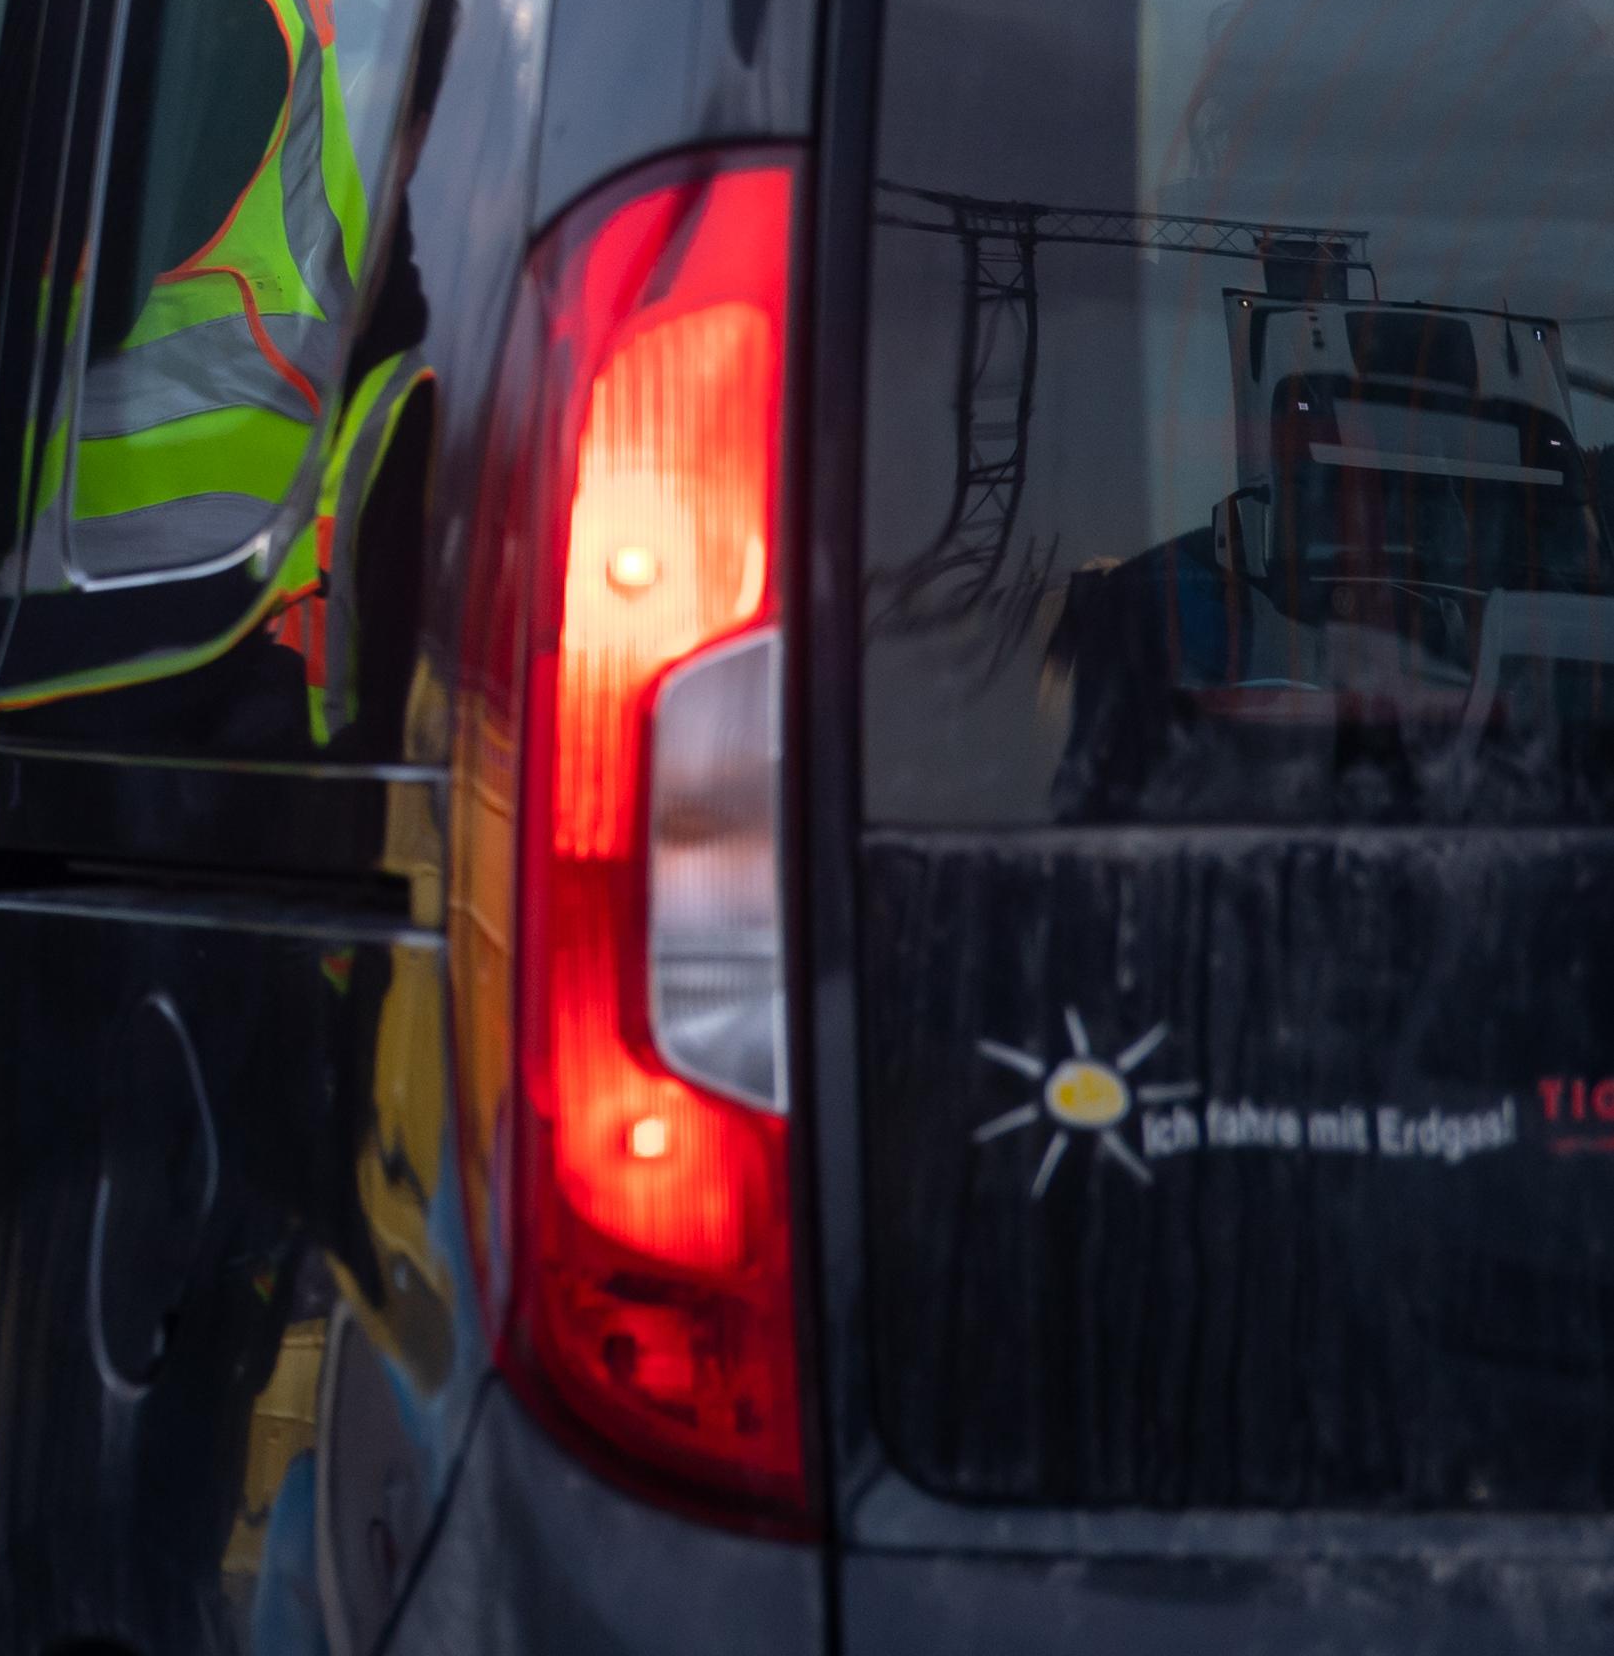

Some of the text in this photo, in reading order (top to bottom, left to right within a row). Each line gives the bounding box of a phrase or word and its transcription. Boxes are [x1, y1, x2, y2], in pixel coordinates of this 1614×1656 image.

[1206, 1097, 1301, 1148] fahre
[1307, 1103, 1368, 1154] mit
[1376, 1096, 1516, 1163] Erdgas!
